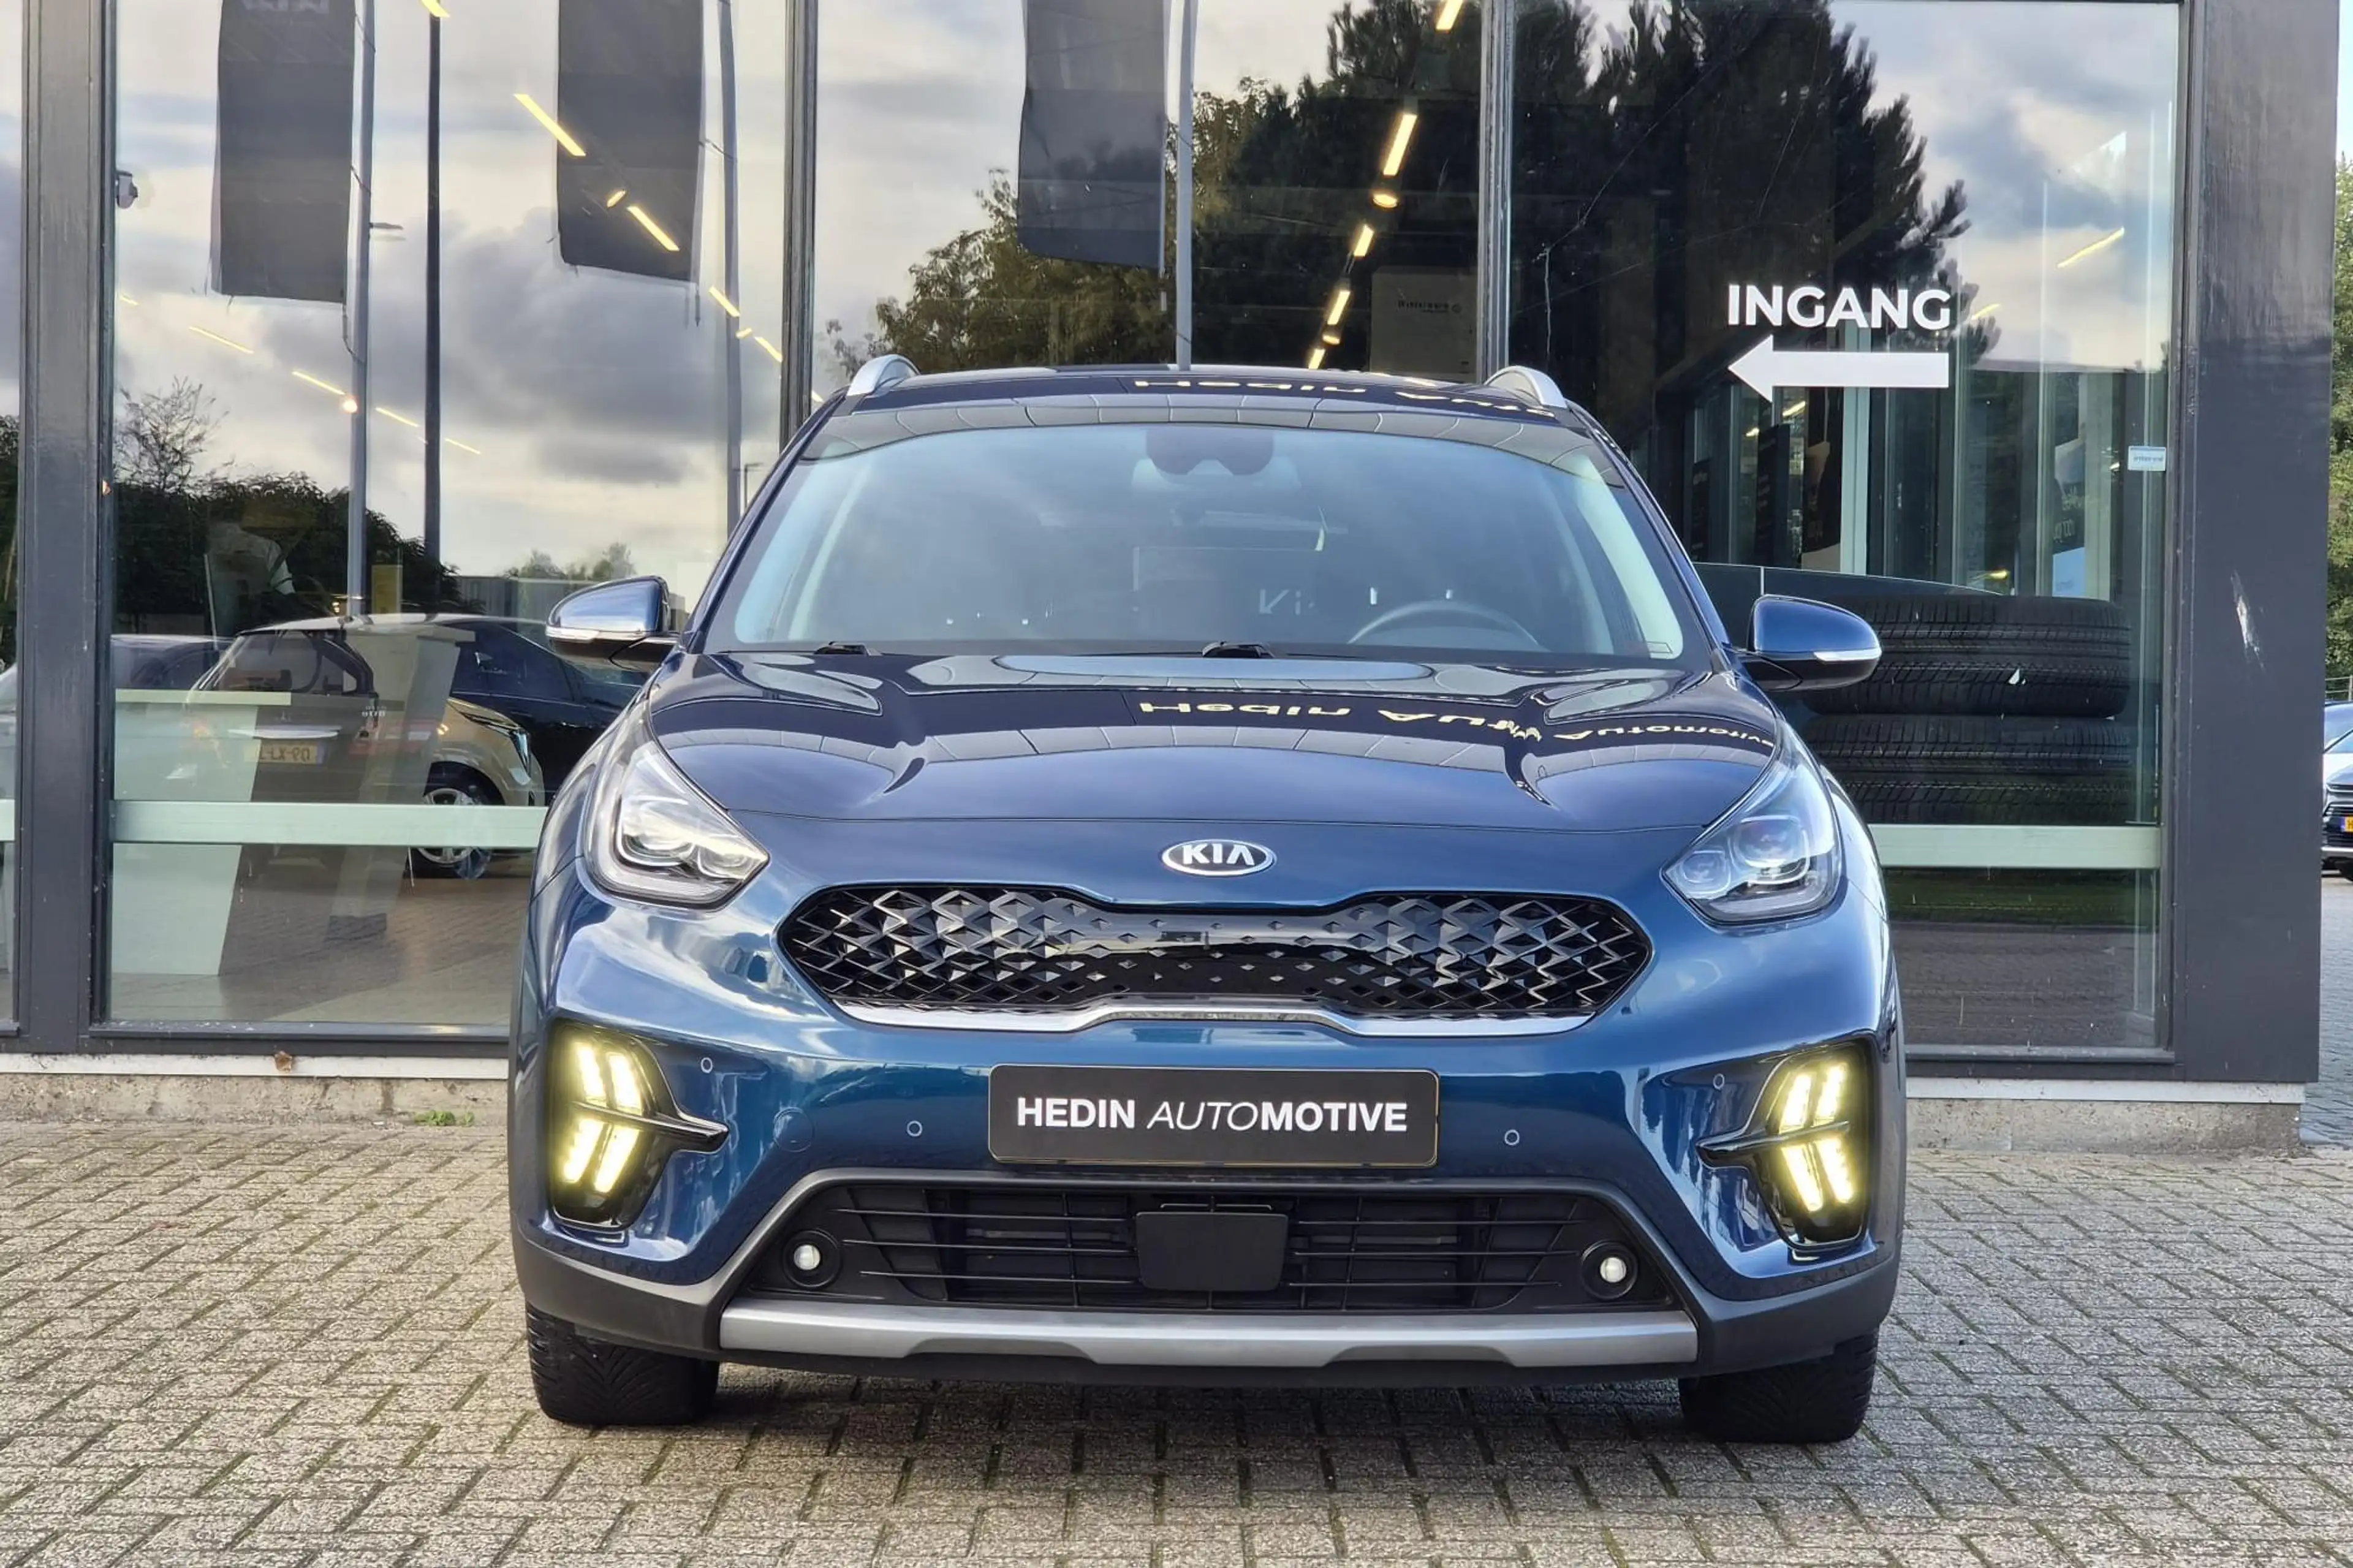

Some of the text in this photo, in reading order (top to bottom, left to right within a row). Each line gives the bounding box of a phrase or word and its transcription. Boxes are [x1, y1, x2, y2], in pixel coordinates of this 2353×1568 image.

[1728, 284, 1951, 330] INGANG
[1181, 843, 1255, 866] KIA
[1017, 1097, 1408, 1132] HEDIN AUTOMOTIVE
